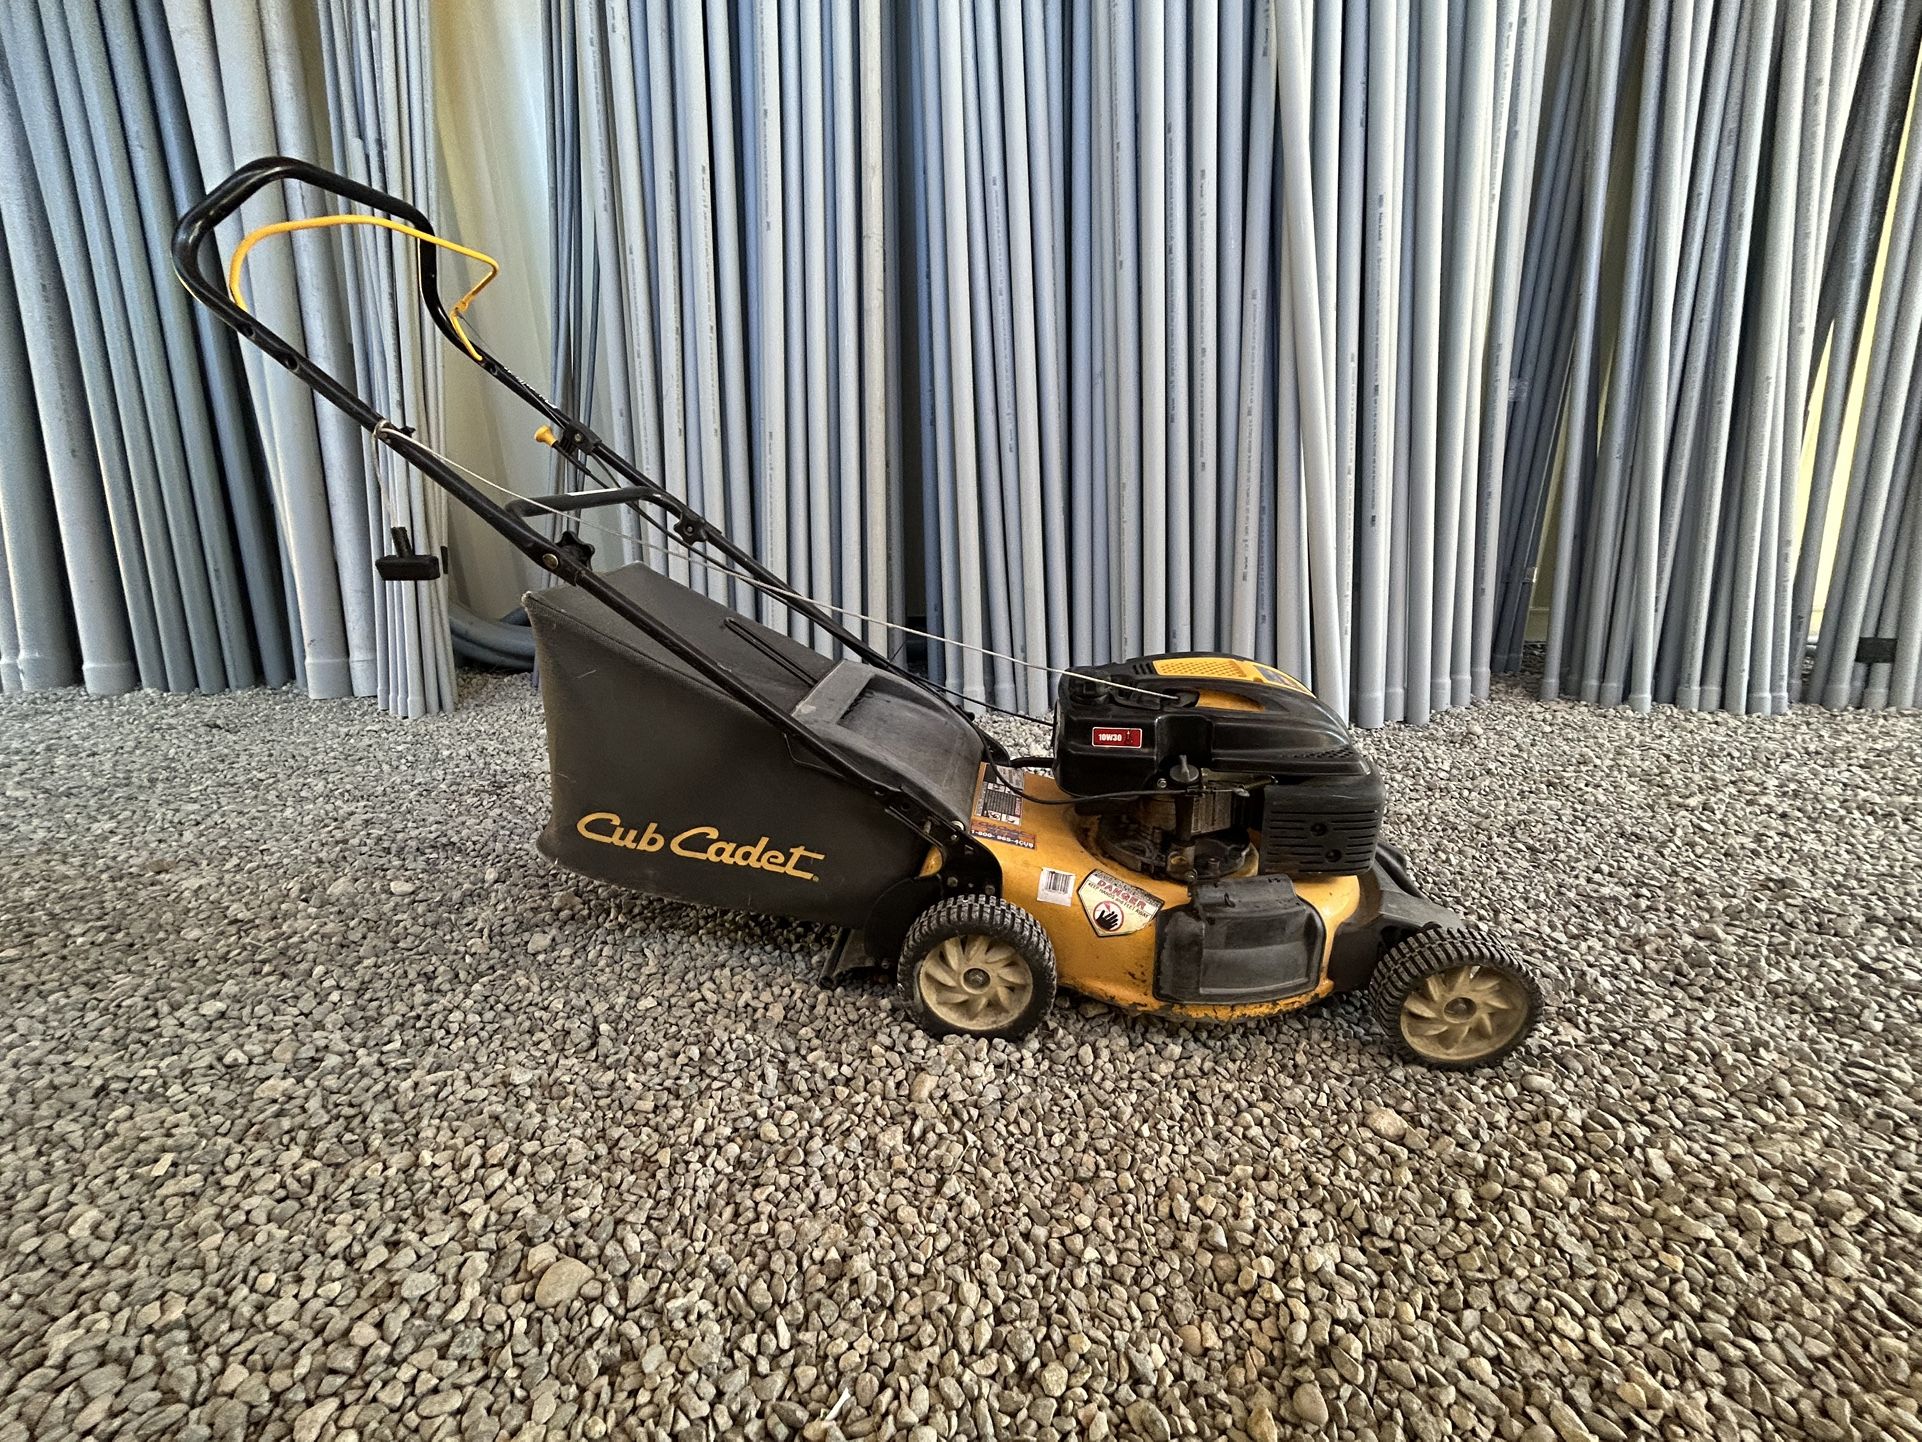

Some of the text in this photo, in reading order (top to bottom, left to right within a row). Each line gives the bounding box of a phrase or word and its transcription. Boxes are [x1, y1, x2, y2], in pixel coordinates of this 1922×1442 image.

[1098, 733, 1122, 742] 10W30
[576, 812, 825, 880] Cub Cadet
[1088, 881, 1100, 890] KEEP
[1099, 887, 1115, 899] HANDS
[1124, 902, 1135, 911] FEET
[1135, 907, 1150, 918] AWAY
[1097, 879, 1147, 910] DANGER
